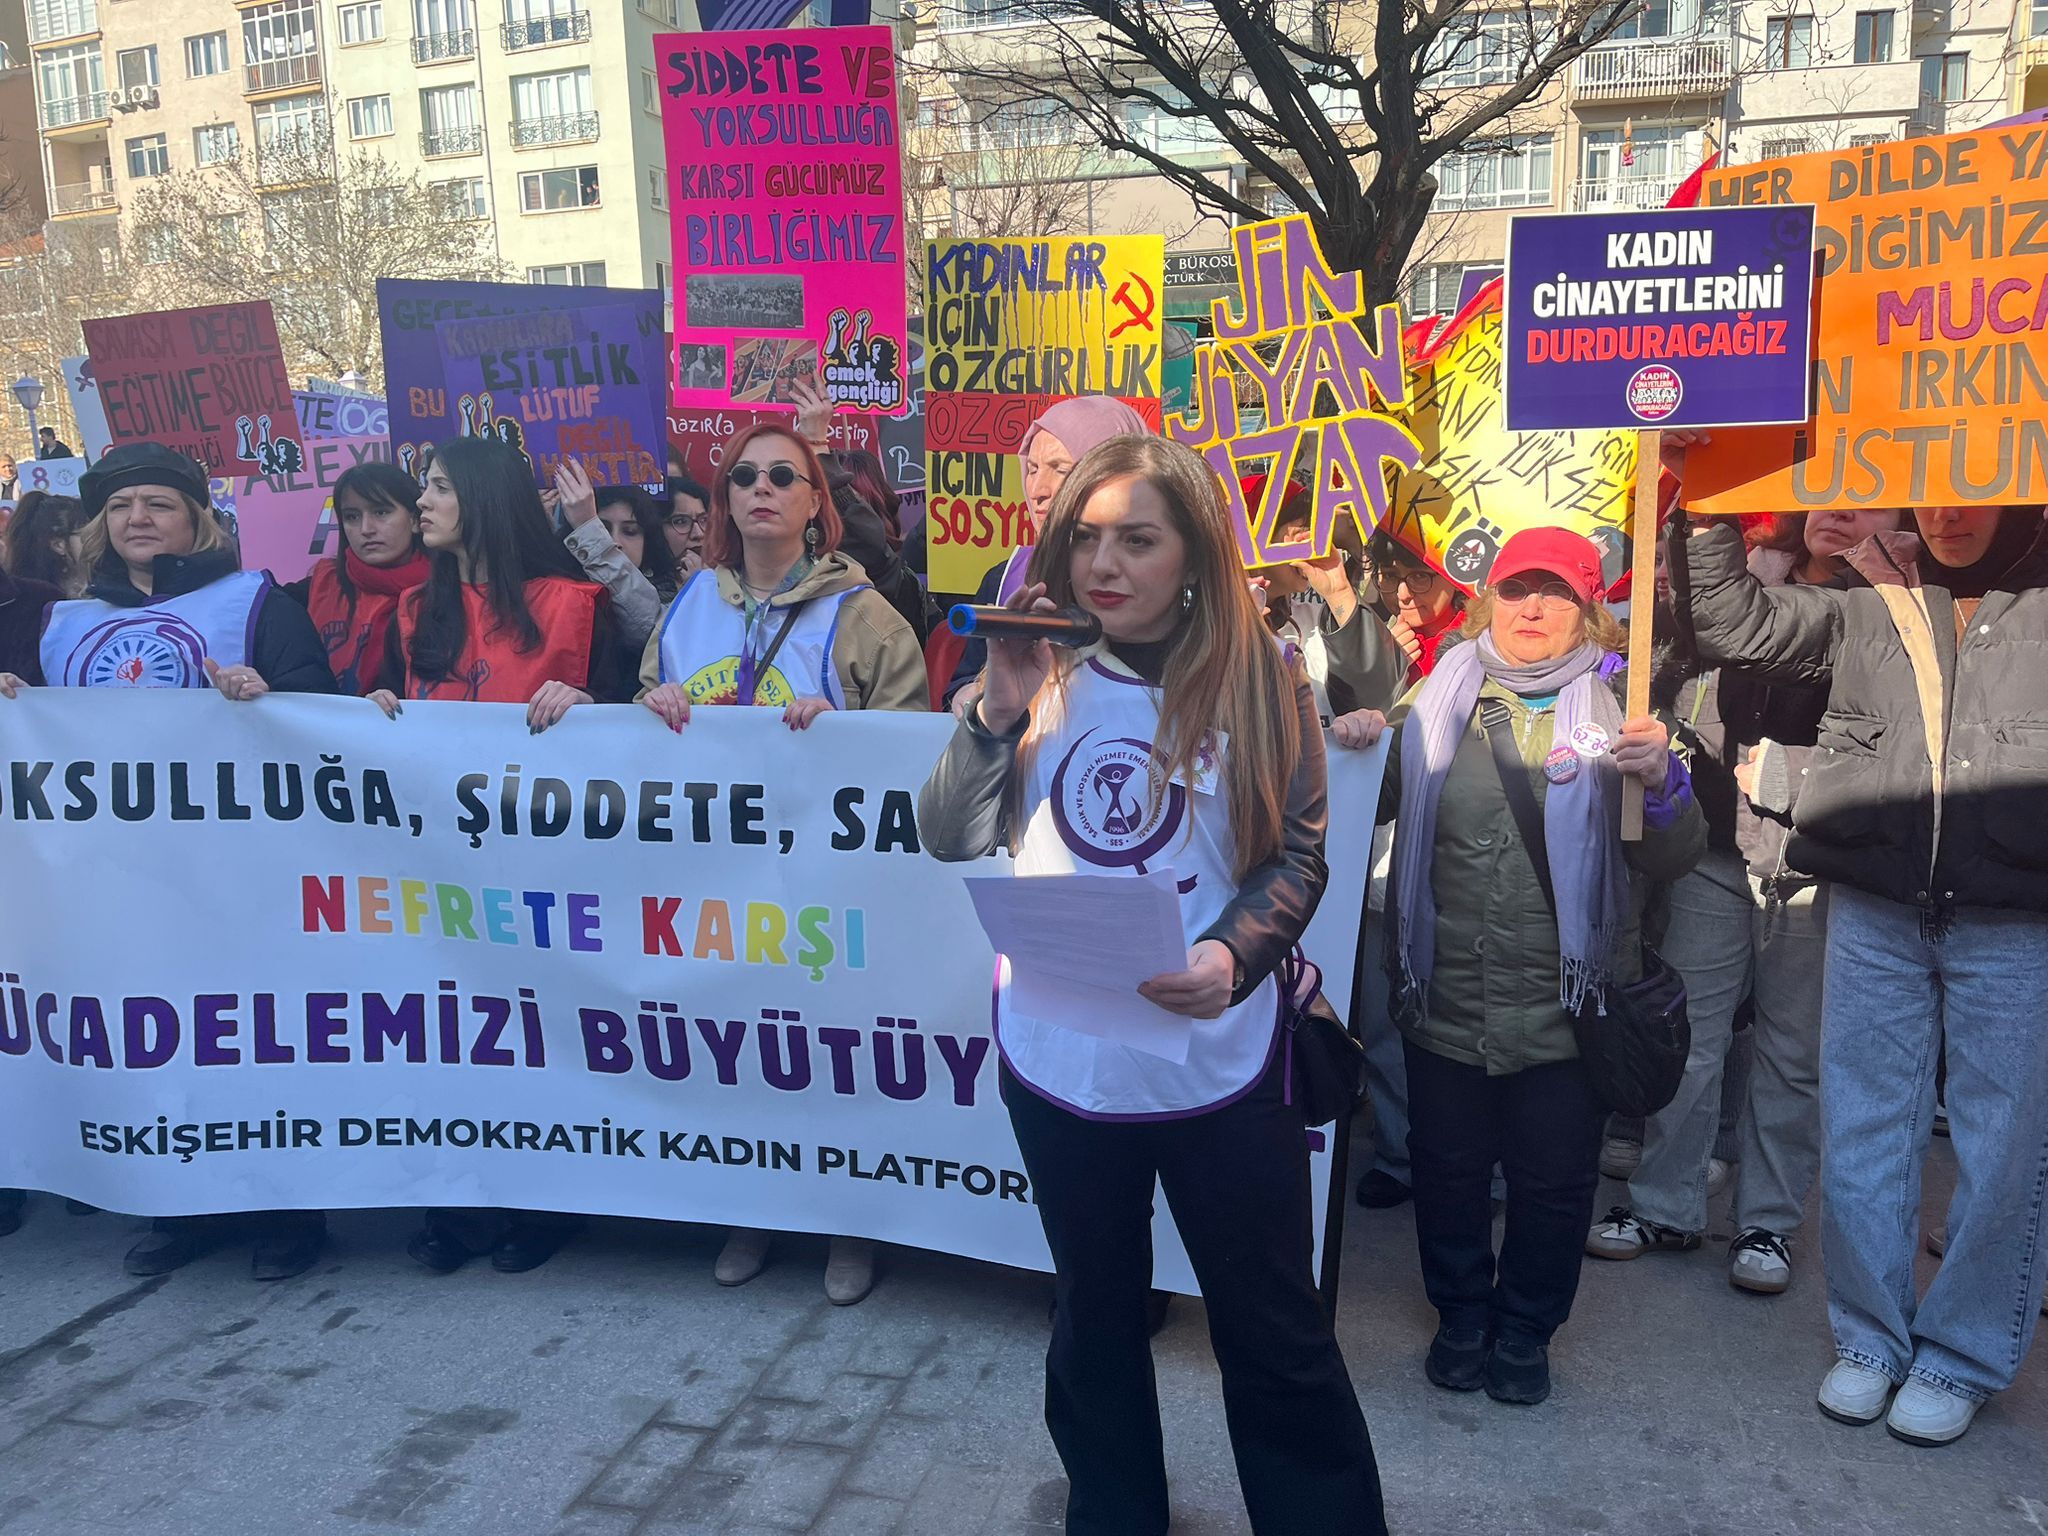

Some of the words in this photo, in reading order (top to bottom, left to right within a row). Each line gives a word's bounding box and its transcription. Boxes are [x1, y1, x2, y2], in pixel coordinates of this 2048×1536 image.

[667, 43, 824, 98] ŞİDDETE
[840, 46, 891, 98] VE
[690, 101, 893, 148] YOKSULLUĞA
[680, 163, 754, 200] KARŞI
[765, 157, 885, 197] GÜCÜMÜZ
[1709, 167, 1794, 207] HER
[1828, 138, 1979, 202] DİLDE
[686, 207, 896, 267] BİRLİĞİMİZ
[1606, 229, 1713, 269] KADIN
[927, 241, 1109, 294] KADINLAR
[1532, 263, 1785, 318] CİNAYETLERİNİ
[928, 293, 1001, 348] İÇİN
[1526, 311, 1788, 363] DURDURACAĞIZ
[480, 331, 641, 396] EŞİTLİK
[825, 361, 877, 382] emek
[929, 343, 1158, 398] ÖZGÜRLÜK
[1640, 372, 1670, 381] KADIN
[408, 386, 446, 418] BU
[519, 384, 601, 424] LÜTUF
[828, 380, 899, 405] gençliği
[0, 753, 424, 837] KSULLUĞA,
[456, 763, 795, 855] ŞİDDETE,
[1108, 825, 1125, 833] 1996
[1109, 838, 1124, 847] SES
[301, 875, 603, 953] NEFRETE
[641, 896, 867, 983] KARŞI
[80, 1109, 323, 1164] ESKİŞEHİR
[339, 1116, 646, 1159] DEMOKRATİK
[659, 1130, 801, 1172] KADIN
[818, 1145, 1038, 1207] PLATFOR
